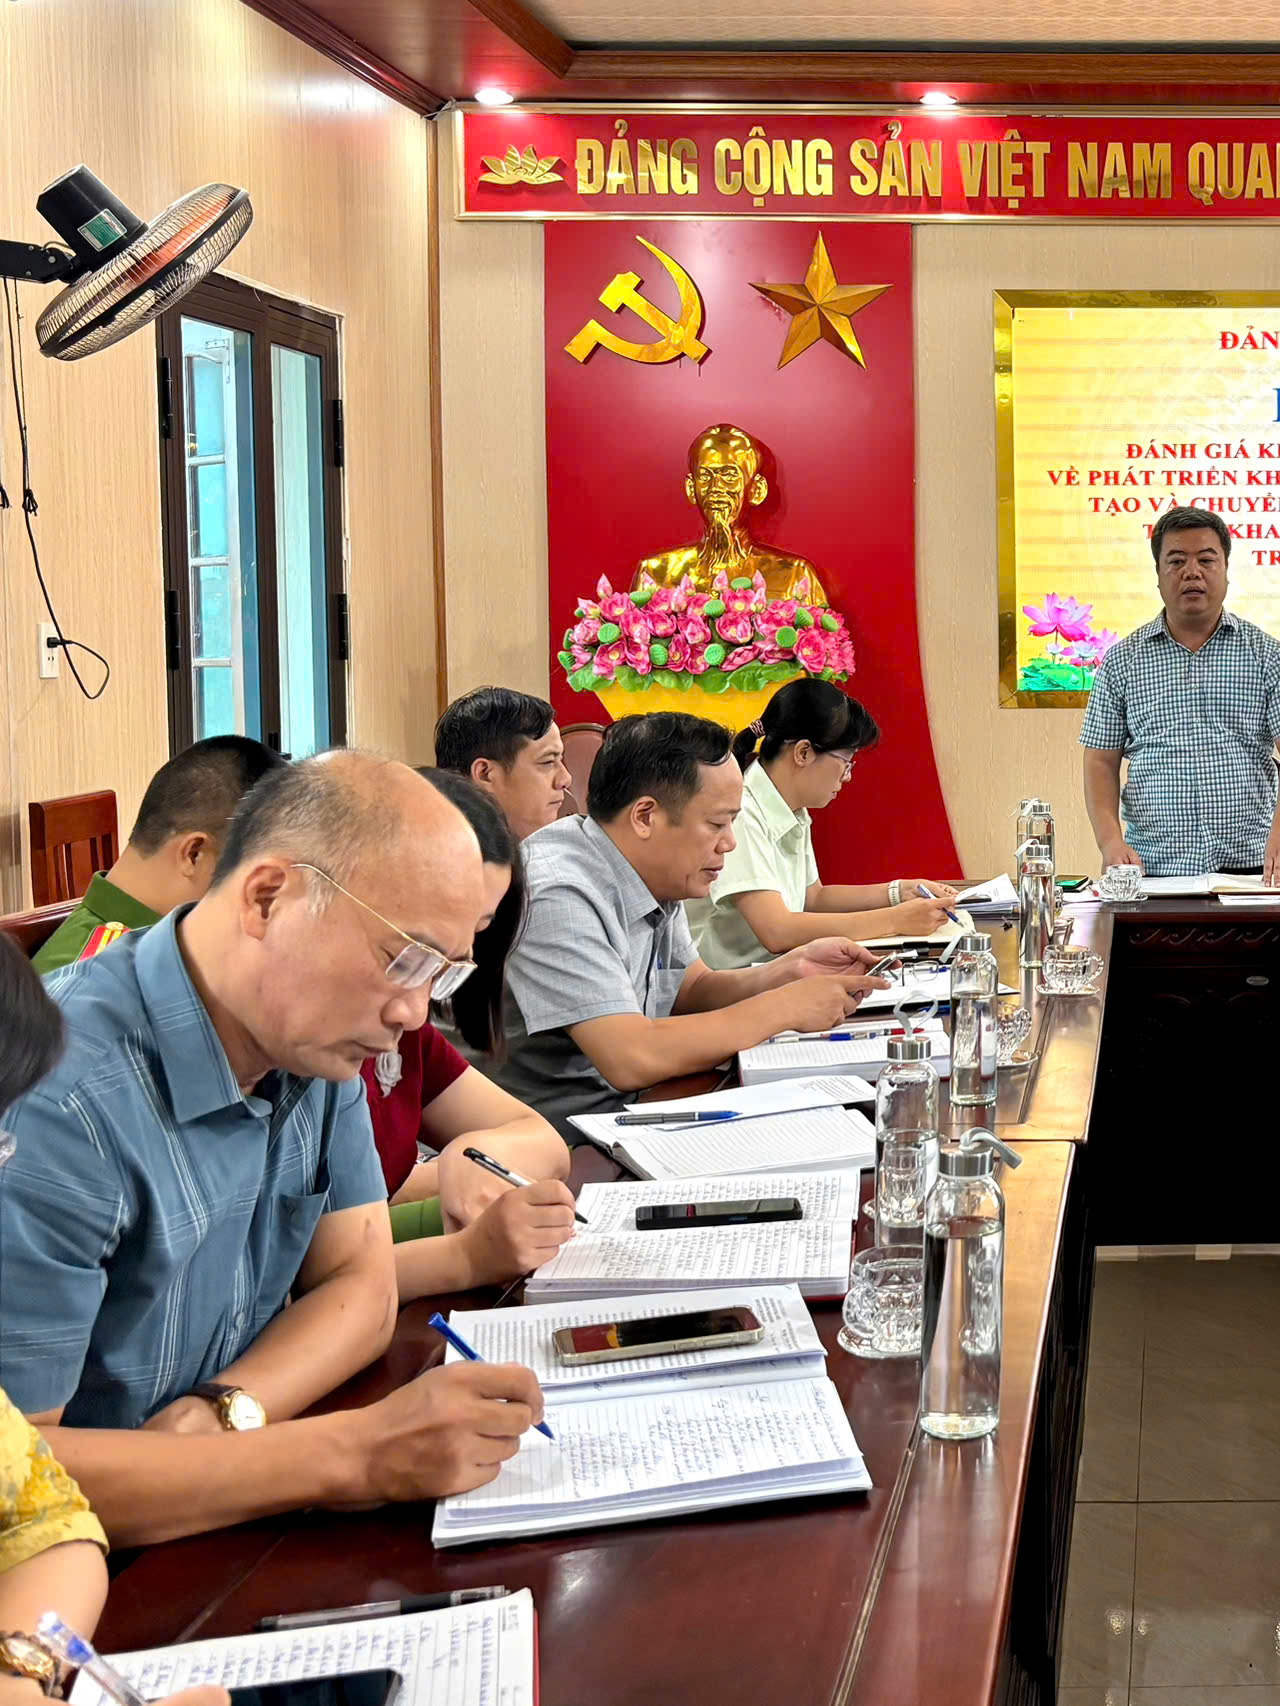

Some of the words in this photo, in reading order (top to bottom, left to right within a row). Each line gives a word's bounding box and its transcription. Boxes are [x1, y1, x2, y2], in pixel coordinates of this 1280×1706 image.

[575, 119, 697, 194] ĐẢNG
[714, 126, 834, 207] CỘNG
[850, 119, 942, 197] SẢN
[958, 128, 1051, 208] VIỆT
[1067, 142, 1172, 199] NAM
[1126, 438, 1197, 458] ĐÁNH
[1204, 438, 1251, 459] GIÁ
[1047, 465, 1081, 486] VỀ
[1087, 465, 1156, 485] PHÁT
[1161, 465, 1238, 485] TRIỂN
[1088, 497, 1141, 516] TẠO
[1147, 492, 1179, 513] VÀ
